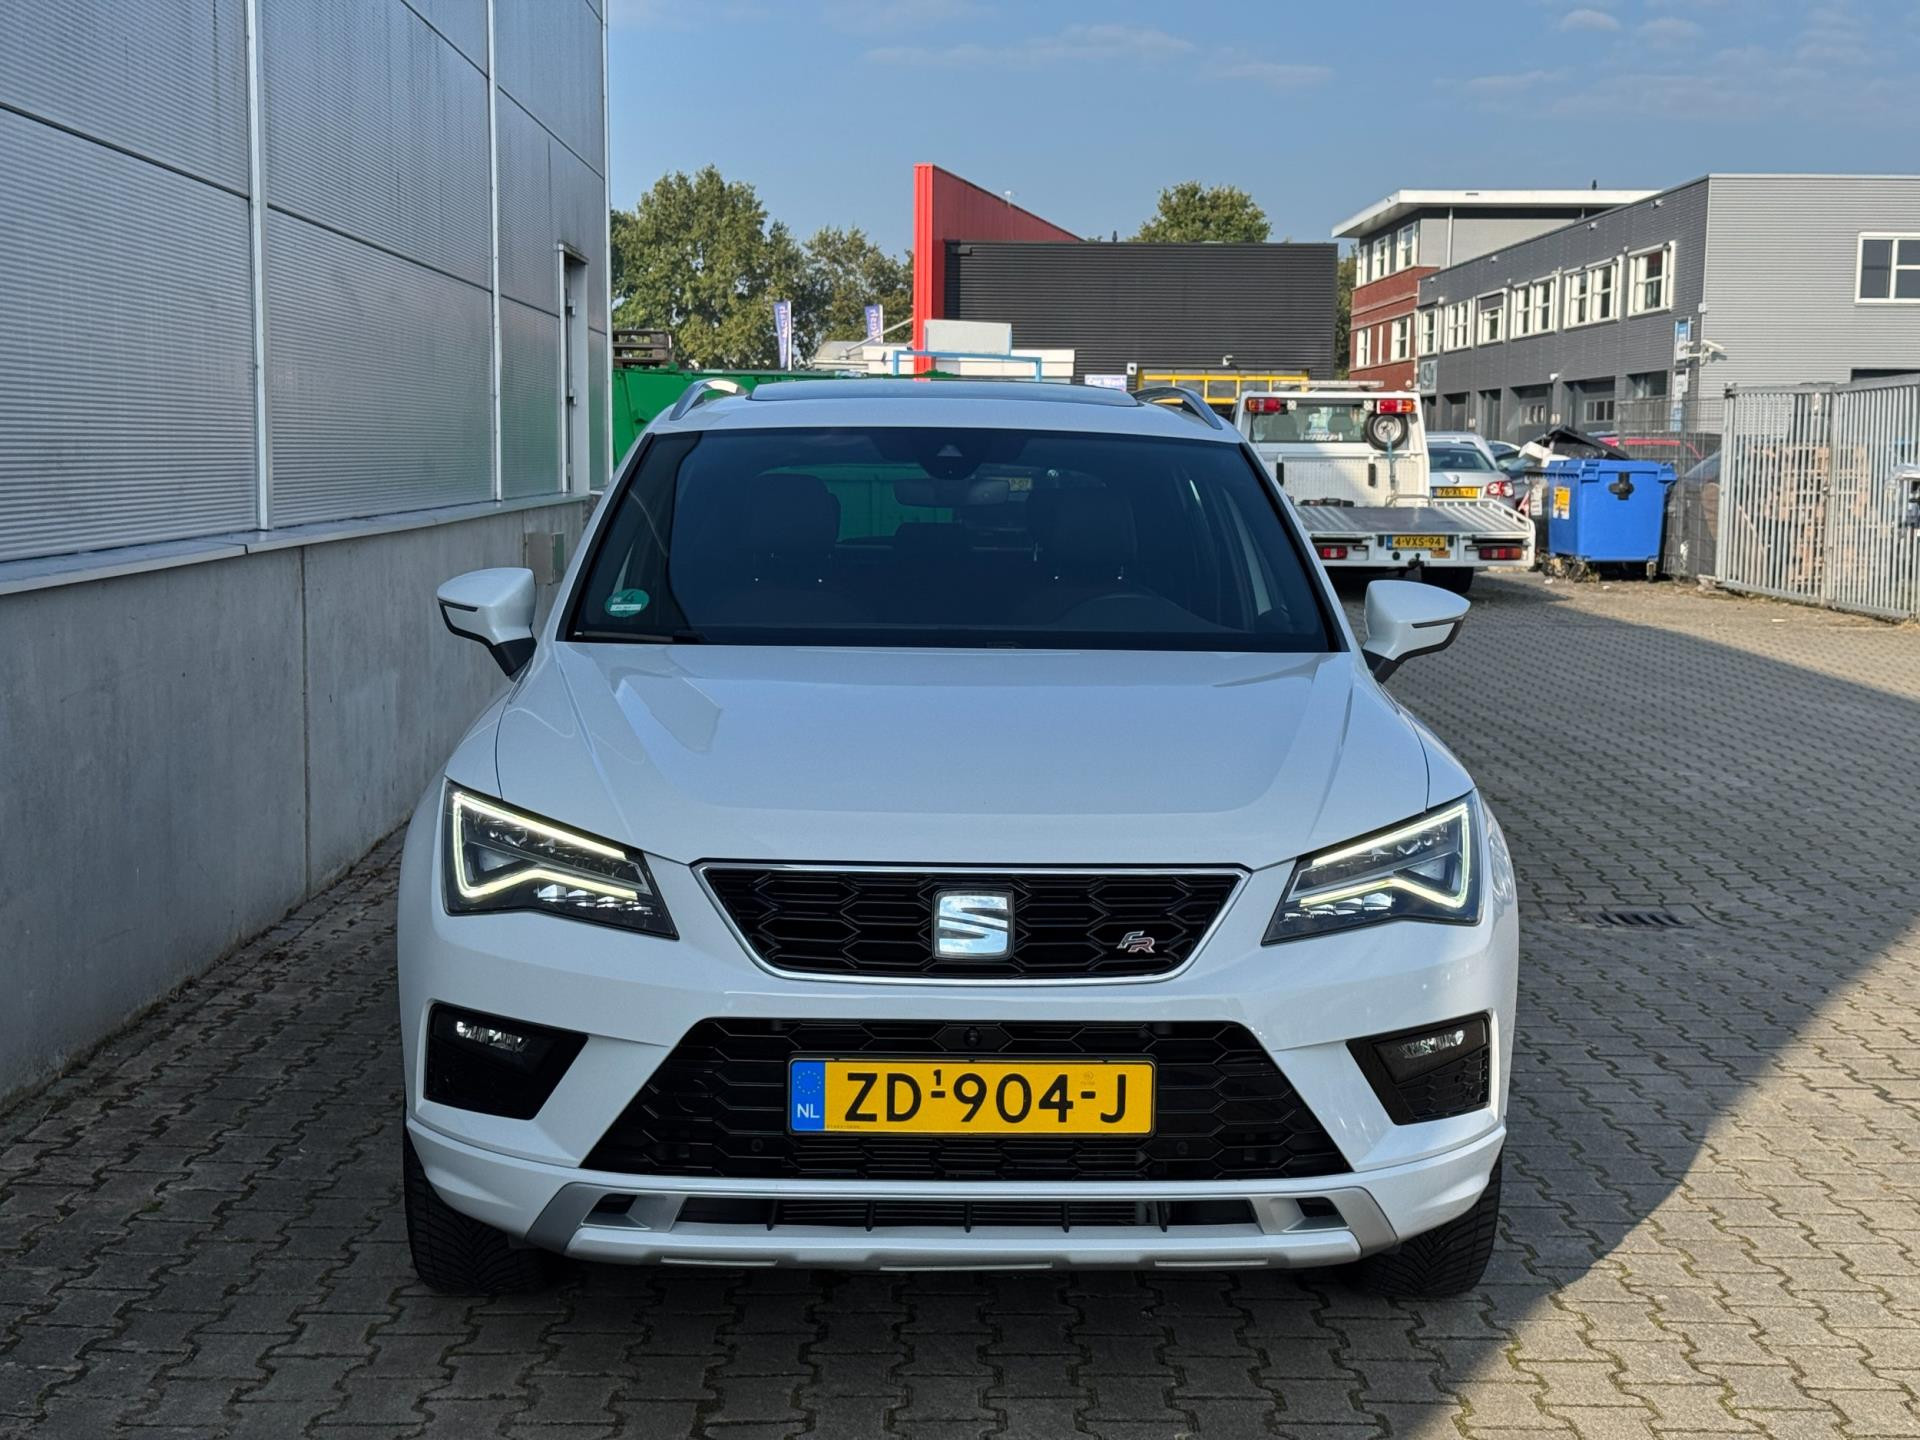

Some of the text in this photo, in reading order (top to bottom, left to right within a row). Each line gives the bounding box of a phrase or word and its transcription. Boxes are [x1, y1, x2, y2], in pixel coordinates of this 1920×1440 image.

[1103, 375, 1126, 386] Wash
[1394, 537, 1441, 547] 4-VXS-94
[1117, 931, 1155, 953] FR
[797, 1104, 820, 1119] NL
